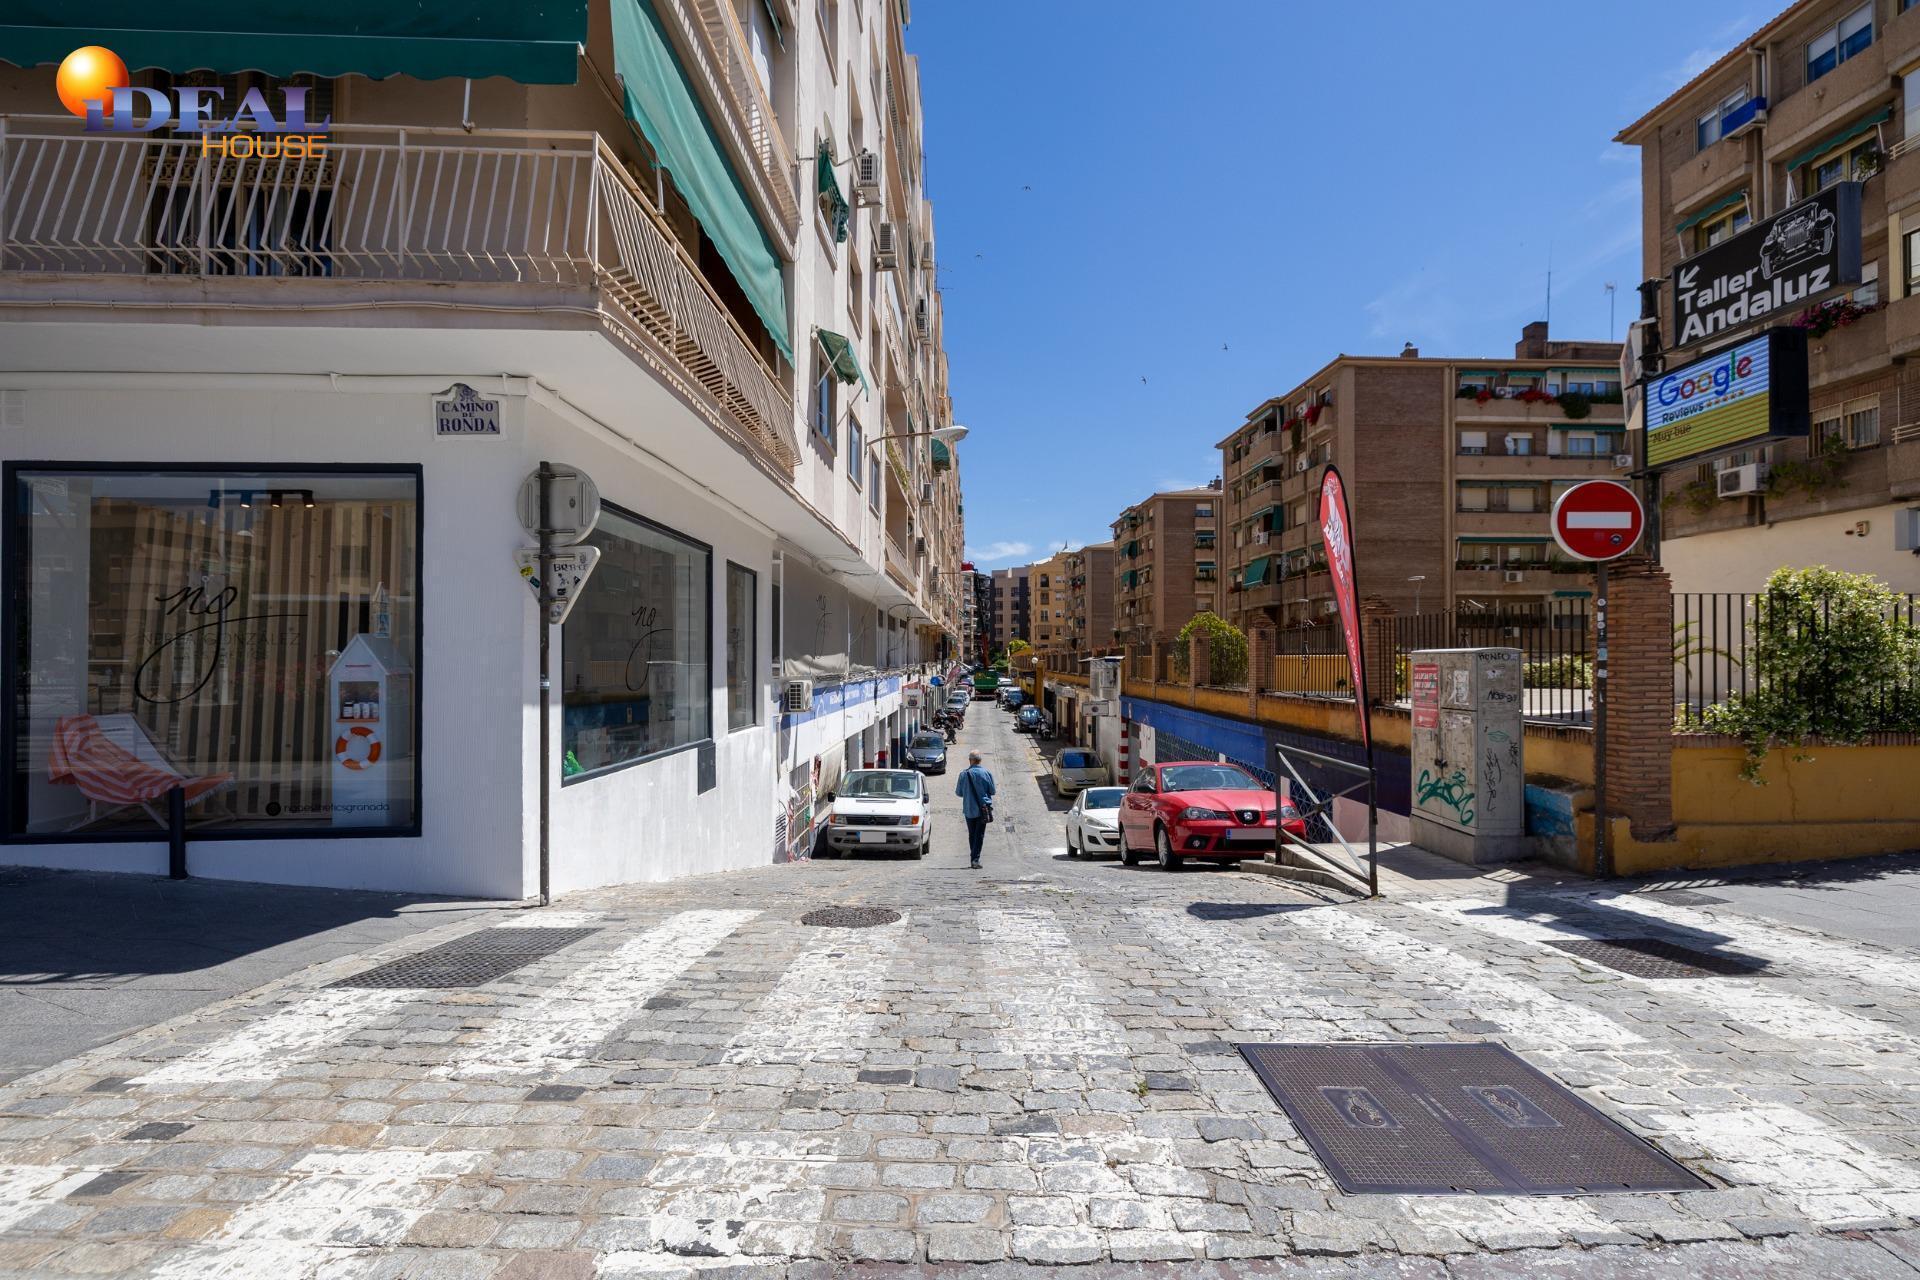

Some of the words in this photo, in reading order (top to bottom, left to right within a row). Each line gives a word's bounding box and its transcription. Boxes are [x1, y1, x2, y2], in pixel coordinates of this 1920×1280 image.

[1678, 266, 1759, 315] Taller
[1679, 264, 1831, 345] Andaluz
[1659, 351, 1753, 406] Google
[441, 402, 494, 412] CAMINO
[1662, 404, 1705, 424] Reviews
[440, 418, 497, 432] RONDA
